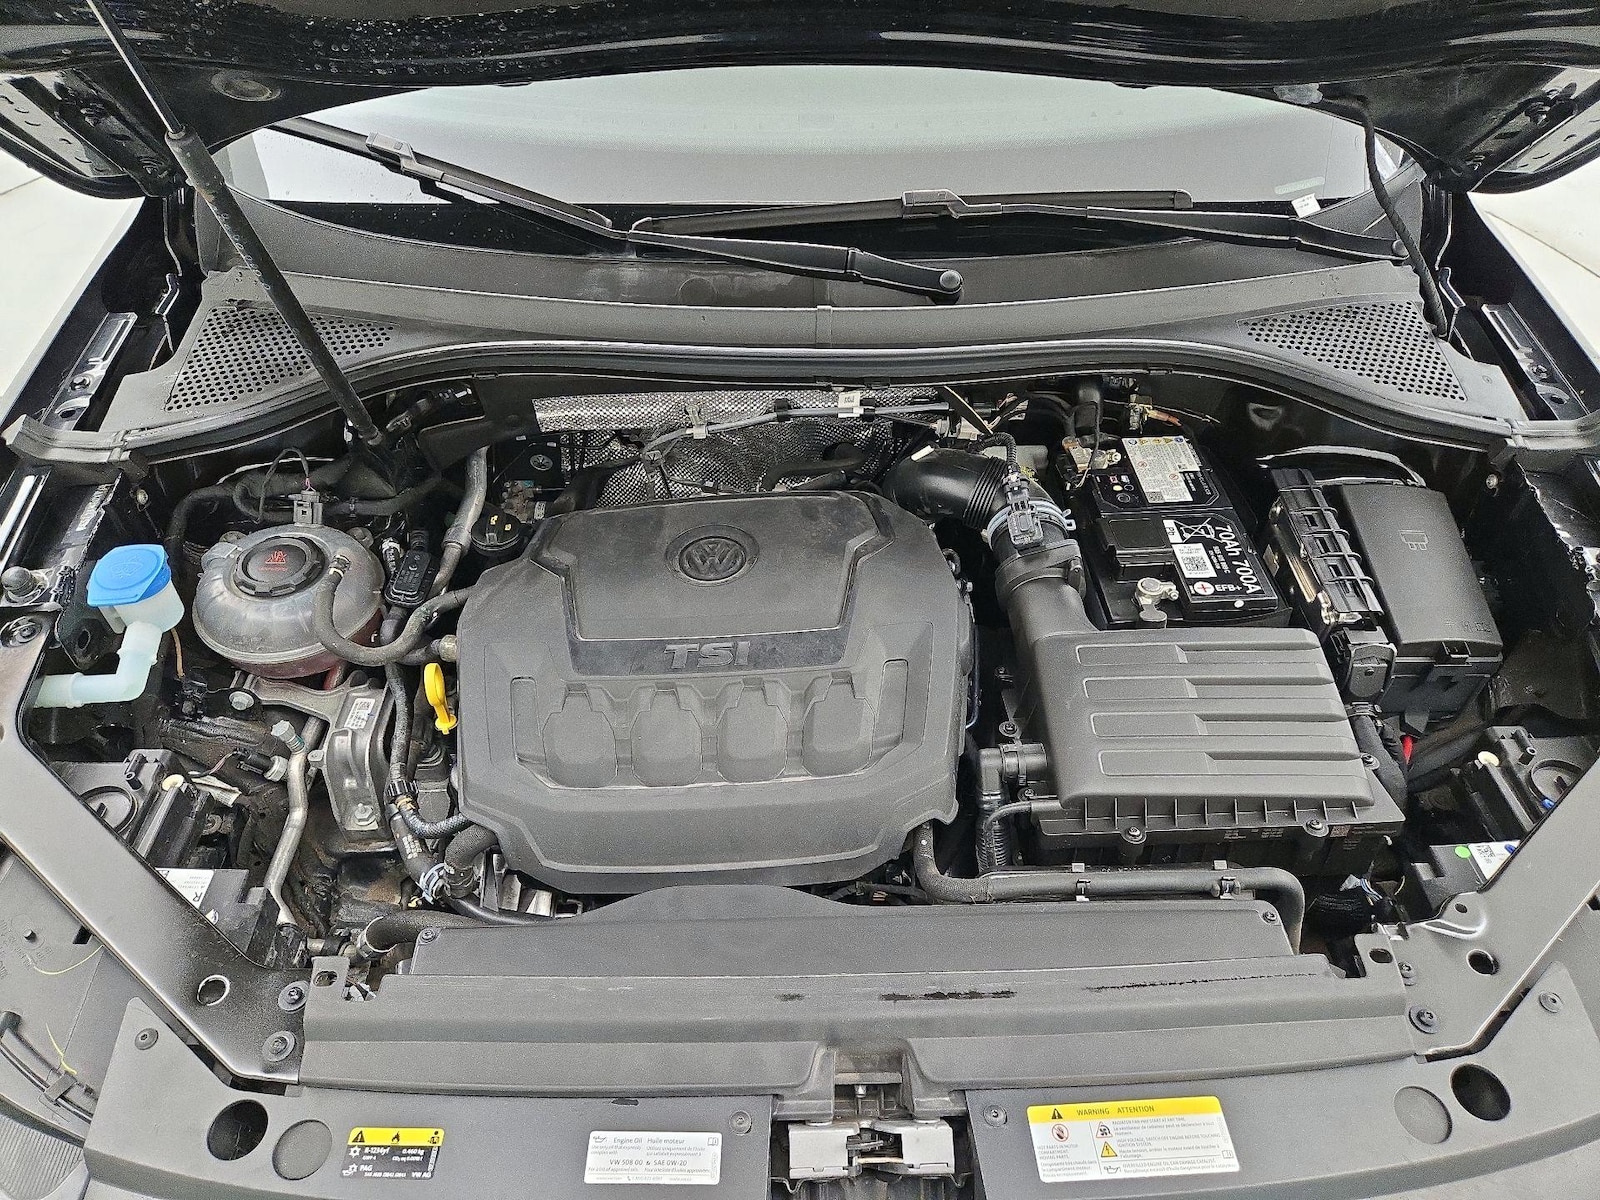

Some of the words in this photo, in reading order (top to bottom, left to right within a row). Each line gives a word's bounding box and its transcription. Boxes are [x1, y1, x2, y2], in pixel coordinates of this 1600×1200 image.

[1215, 525, 1242, 556] 70Ah
[1232, 560, 1262, 594] 700A
[1214, 584, 1242, 592] EFB+
[663, 641, 751, 669] TSI
[1076, 1107, 1110, 1116] WARNING
[1117, 1105, 1155, 1114] ATTENTION
[613, 1137, 634, 1145] Engine
[647, 1137, 663, 1145] Huile
[364, 1147, 390, 1156] R-1234yf
[360, 1164, 374, 1172] PAG
